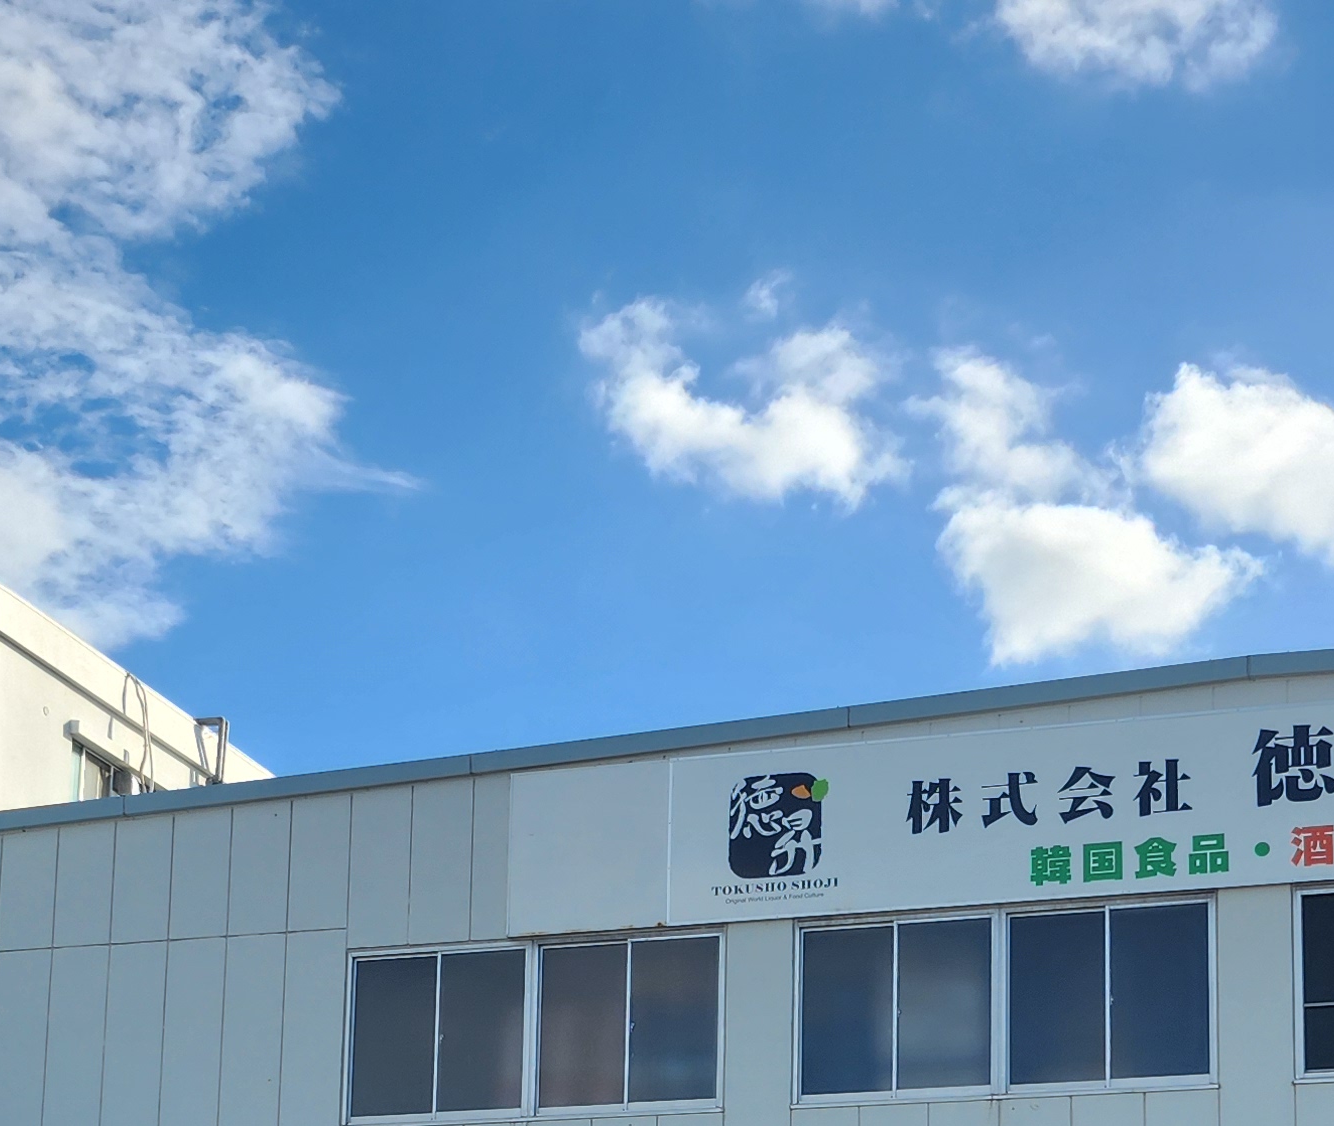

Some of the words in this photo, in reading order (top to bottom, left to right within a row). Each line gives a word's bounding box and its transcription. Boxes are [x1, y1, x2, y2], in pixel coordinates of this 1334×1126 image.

[905, 758, 1193, 835] 株式会社
[711, 880, 787, 897] TOKUSHO
[790, 877, 838, 890] SHOJI
